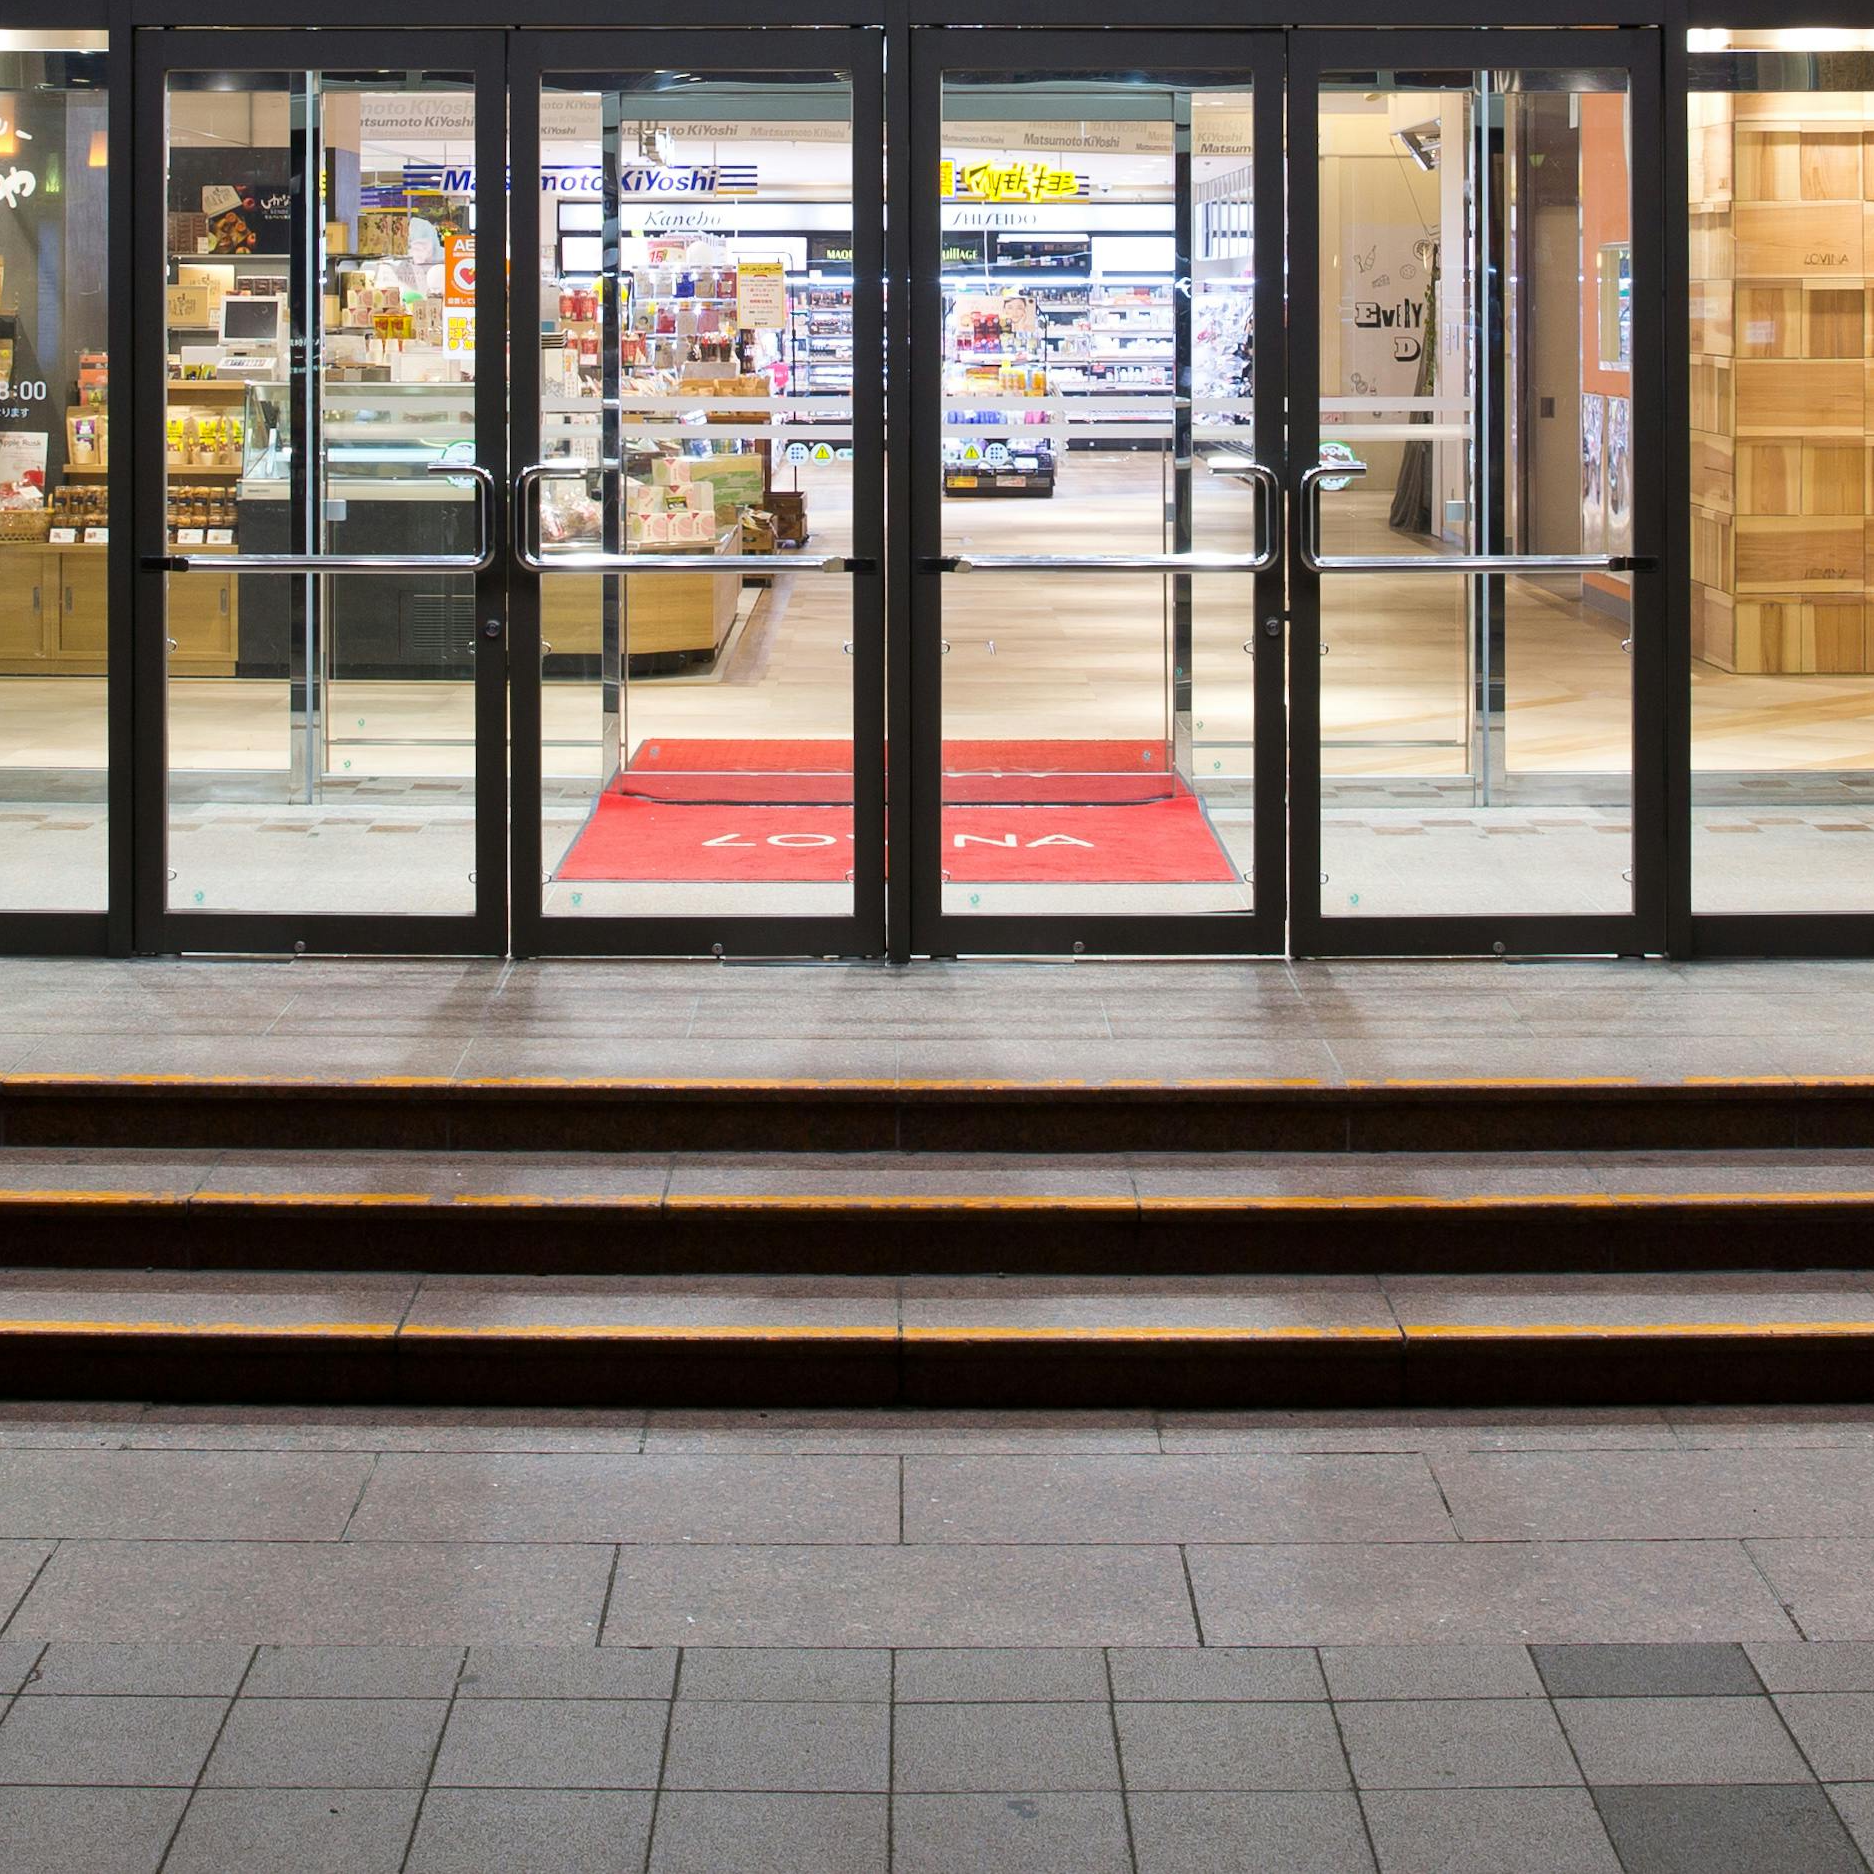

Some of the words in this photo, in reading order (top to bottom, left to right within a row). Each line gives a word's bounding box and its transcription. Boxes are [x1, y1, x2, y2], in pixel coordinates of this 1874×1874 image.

[424, 116, 474, 127] KiYoshi
[541, 126, 577, 135] KiYoshi
[686, 124, 739, 136] KiYoshi
[1023, 133, 1082, 147] Matsumoto
[1083, 136, 1121, 148] KiYoshi
[1200, 143, 1252, 153] Matsum
[621, 169, 718, 192] KiYoshi
[644, 210, 724, 228] Kanebo
[953, 210, 1037, 227] SHISEIDO
[453, 238, 476, 252] AE
[1803, 253, 1850, 266] LOVINA
[700, 832, 1095, 849] LONA
